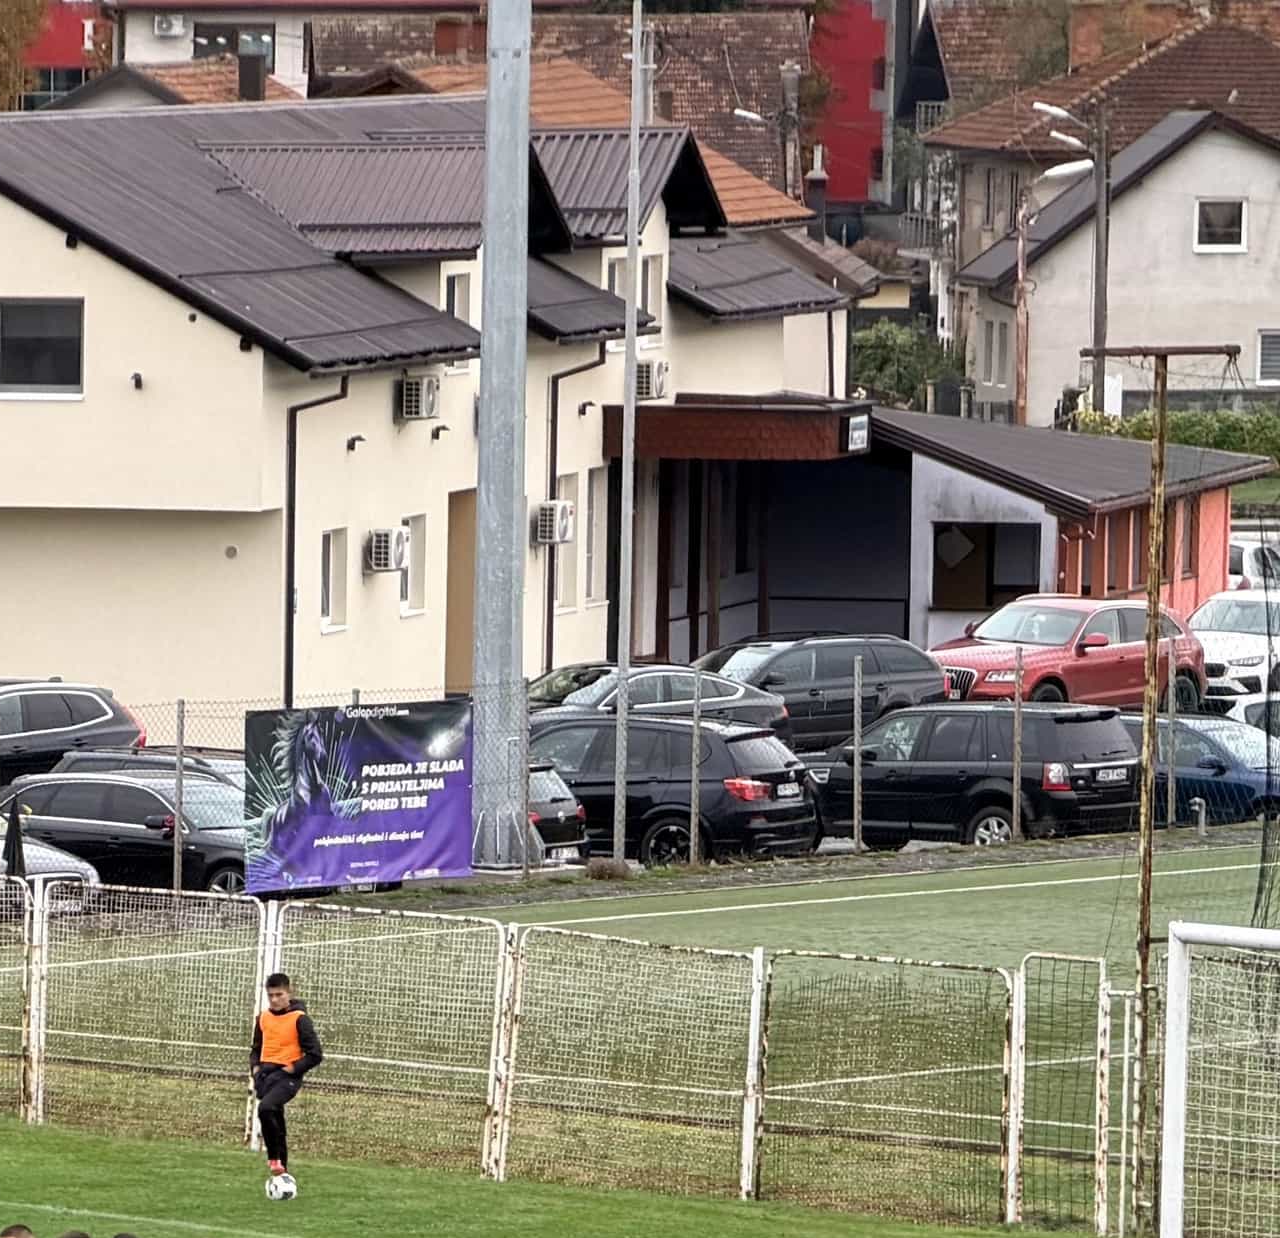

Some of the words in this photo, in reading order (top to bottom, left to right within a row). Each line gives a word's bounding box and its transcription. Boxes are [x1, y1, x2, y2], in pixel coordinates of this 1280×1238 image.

[361, 763, 412, 777] POBJEDA
[414, 761, 428, 774] JE
[361, 782, 369, 794] S
[370, 778, 444, 793] PRIJATELJIMA
[361, 798, 398, 811] PORED
[401, 796, 428, 808] TEBE
